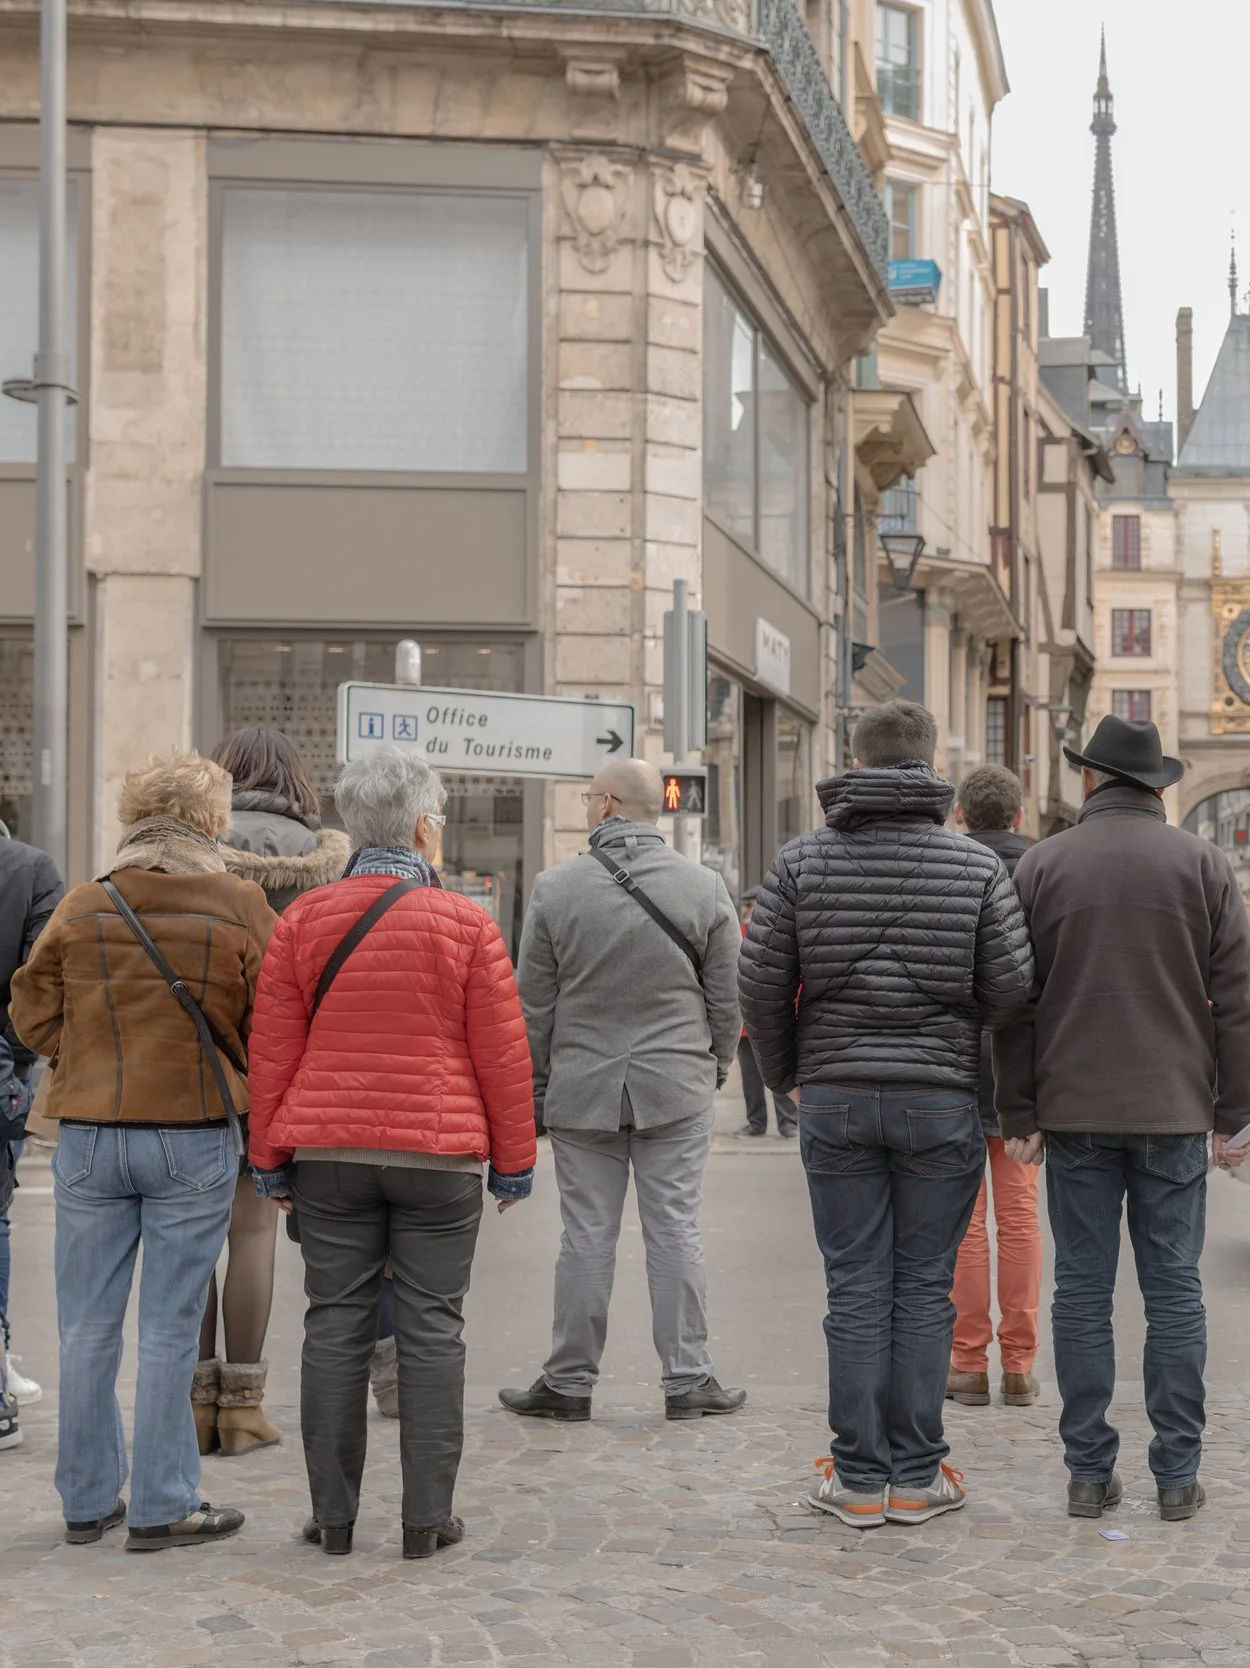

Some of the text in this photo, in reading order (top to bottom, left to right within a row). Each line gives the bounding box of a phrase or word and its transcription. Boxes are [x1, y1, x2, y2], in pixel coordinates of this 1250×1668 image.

[426, 706, 489, 727] Office
[426, 736, 553, 761] du Tourisme
